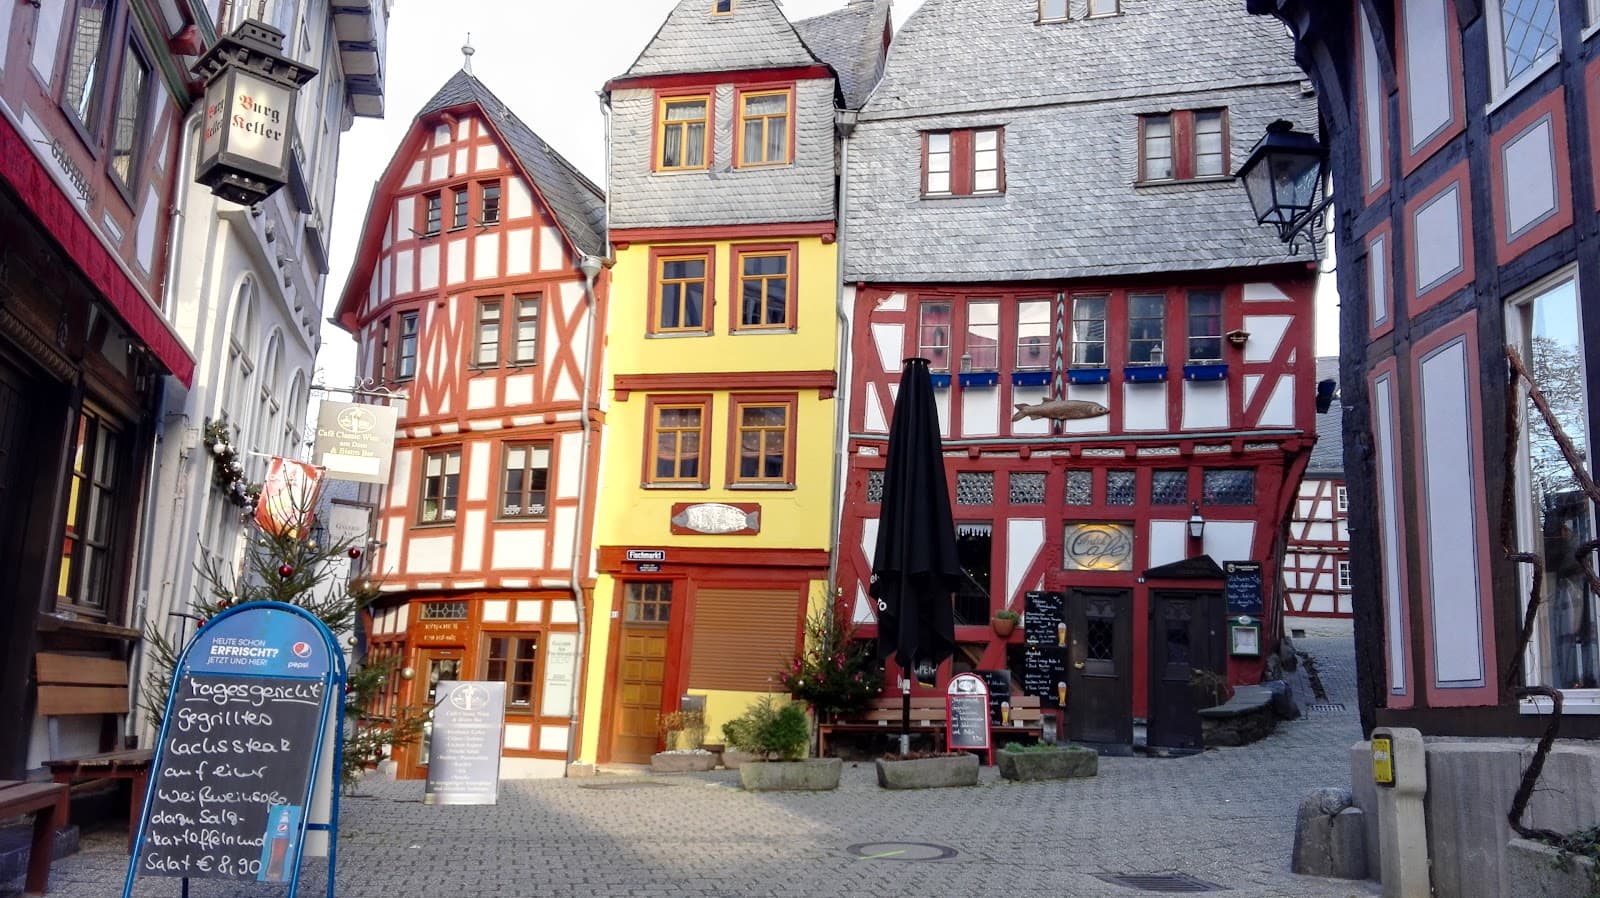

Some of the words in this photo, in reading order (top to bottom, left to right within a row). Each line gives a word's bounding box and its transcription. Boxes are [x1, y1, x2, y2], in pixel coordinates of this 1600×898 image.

[239, 94, 280, 124] Burg
[232, 114, 282, 141] Keller
[630, 551, 661, 559] Fischmarkt
[212, 637, 237, 645] HEUTE
[238, 638, 266, 646] SCHON
[210, 645, 280, 658] ERFRISCHT?
[207, 656, 229, 665] JETZT
[230, 657, 247, 665] UND
[248, 658, 268, 666] HIER!
[287, 661, 309, 669] pepsi
[164, 761, 208, 782] auf
[211, 763, 268, 779] einer
[151, 809, 195, 826] dazu
[145, 852, 191, 872] Salat
[196, 855, 214, 872] €
[217, 855, 262, 875] 8,90
